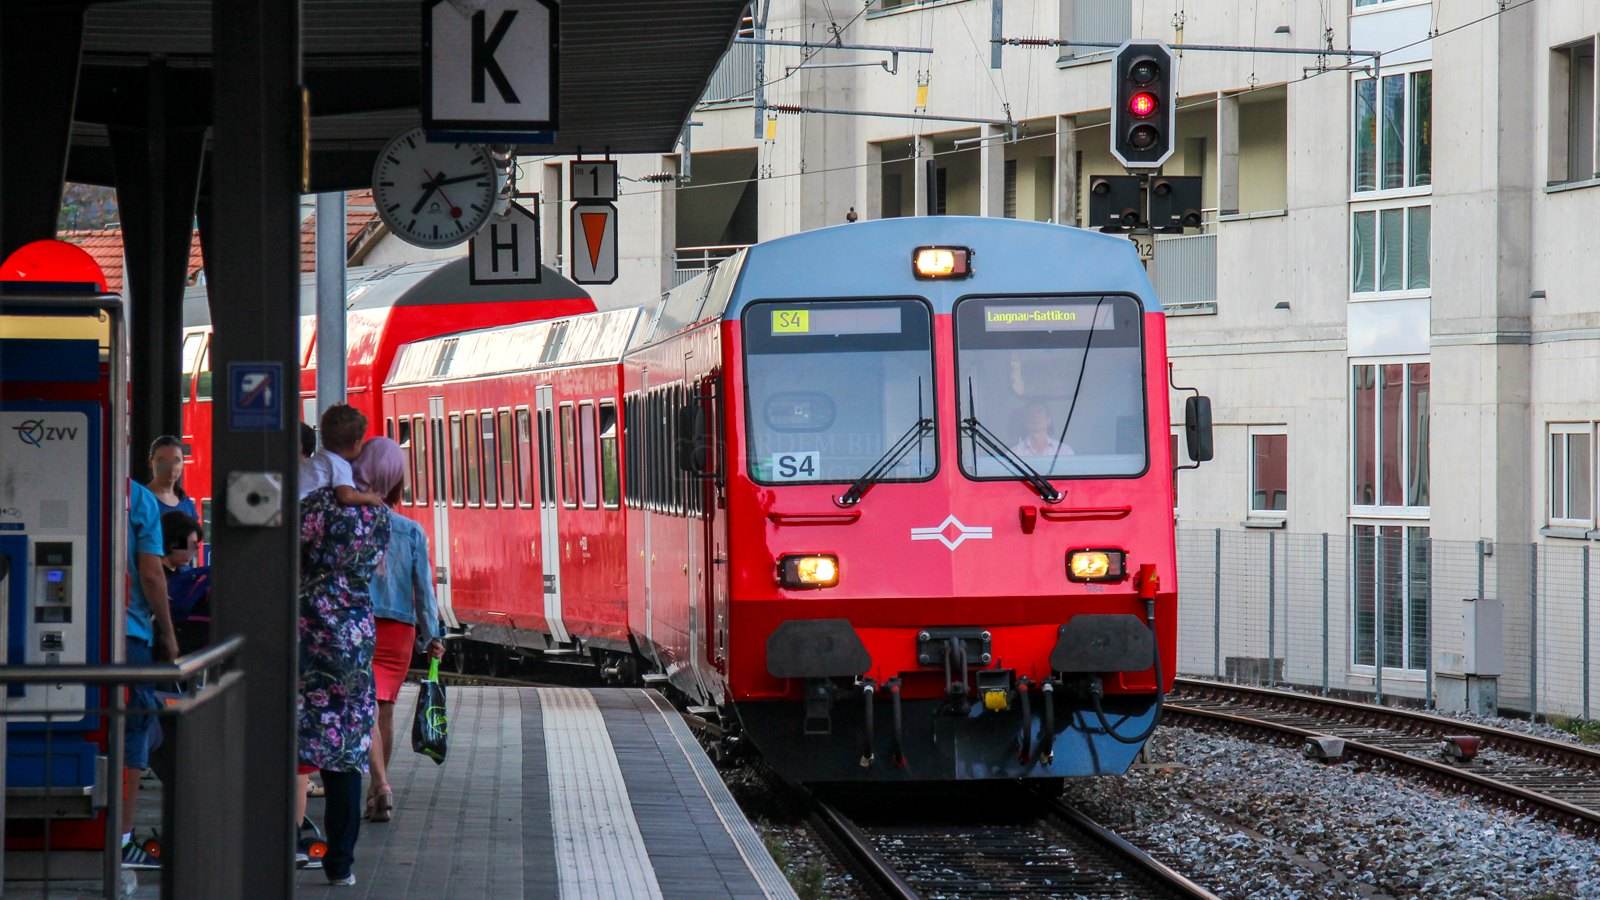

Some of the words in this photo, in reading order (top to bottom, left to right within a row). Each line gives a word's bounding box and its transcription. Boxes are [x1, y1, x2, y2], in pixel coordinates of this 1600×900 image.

[471, 9, 521, 104] K
[590, 166, 599, 196] 1
[491, 224, 519, 273] H
[780, 311, 801, 328] S4
[987, 310, 1077, 324] Langnau-Gattikon
[45, 426, 79, 441] ZVV
[779, 455, 815, 478] S4
